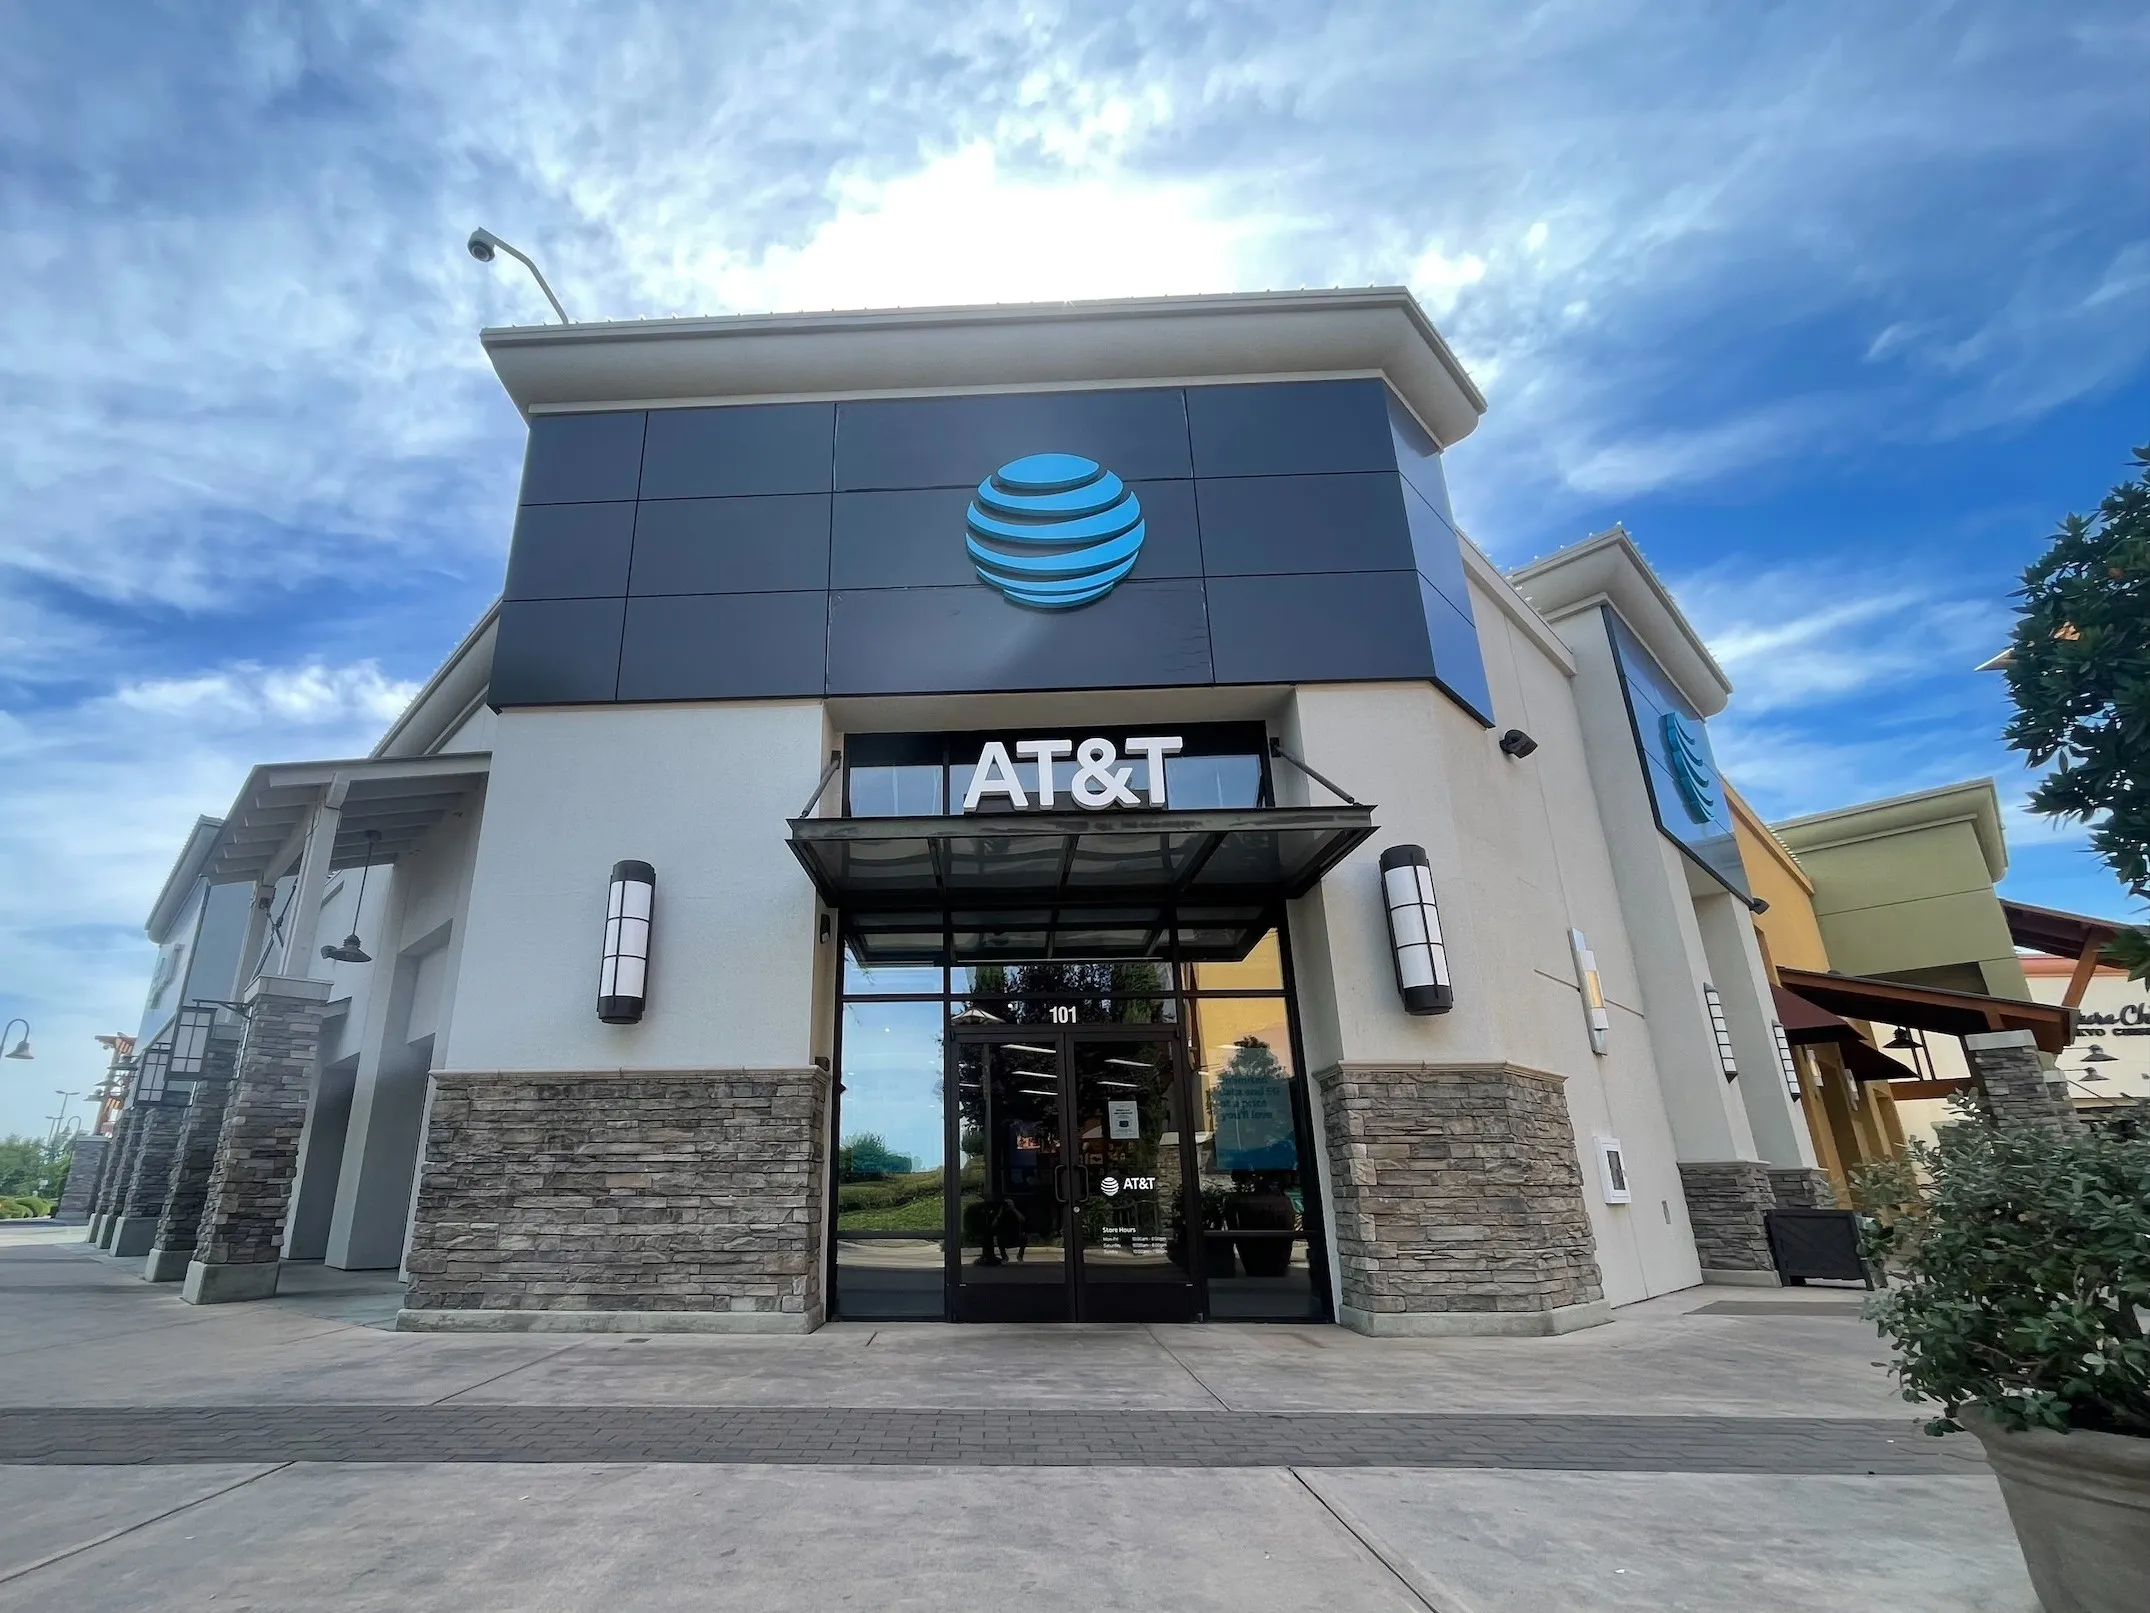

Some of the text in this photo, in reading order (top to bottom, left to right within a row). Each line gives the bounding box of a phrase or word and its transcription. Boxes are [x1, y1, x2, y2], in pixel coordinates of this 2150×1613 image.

[963, 736, 1184, 812] AT&T
[1049, 1005, 1077, 1024] 101
[1123, 1177, 1156, 1190] AT&T
[1102, 1226, 1137, 1234] Store Hours
